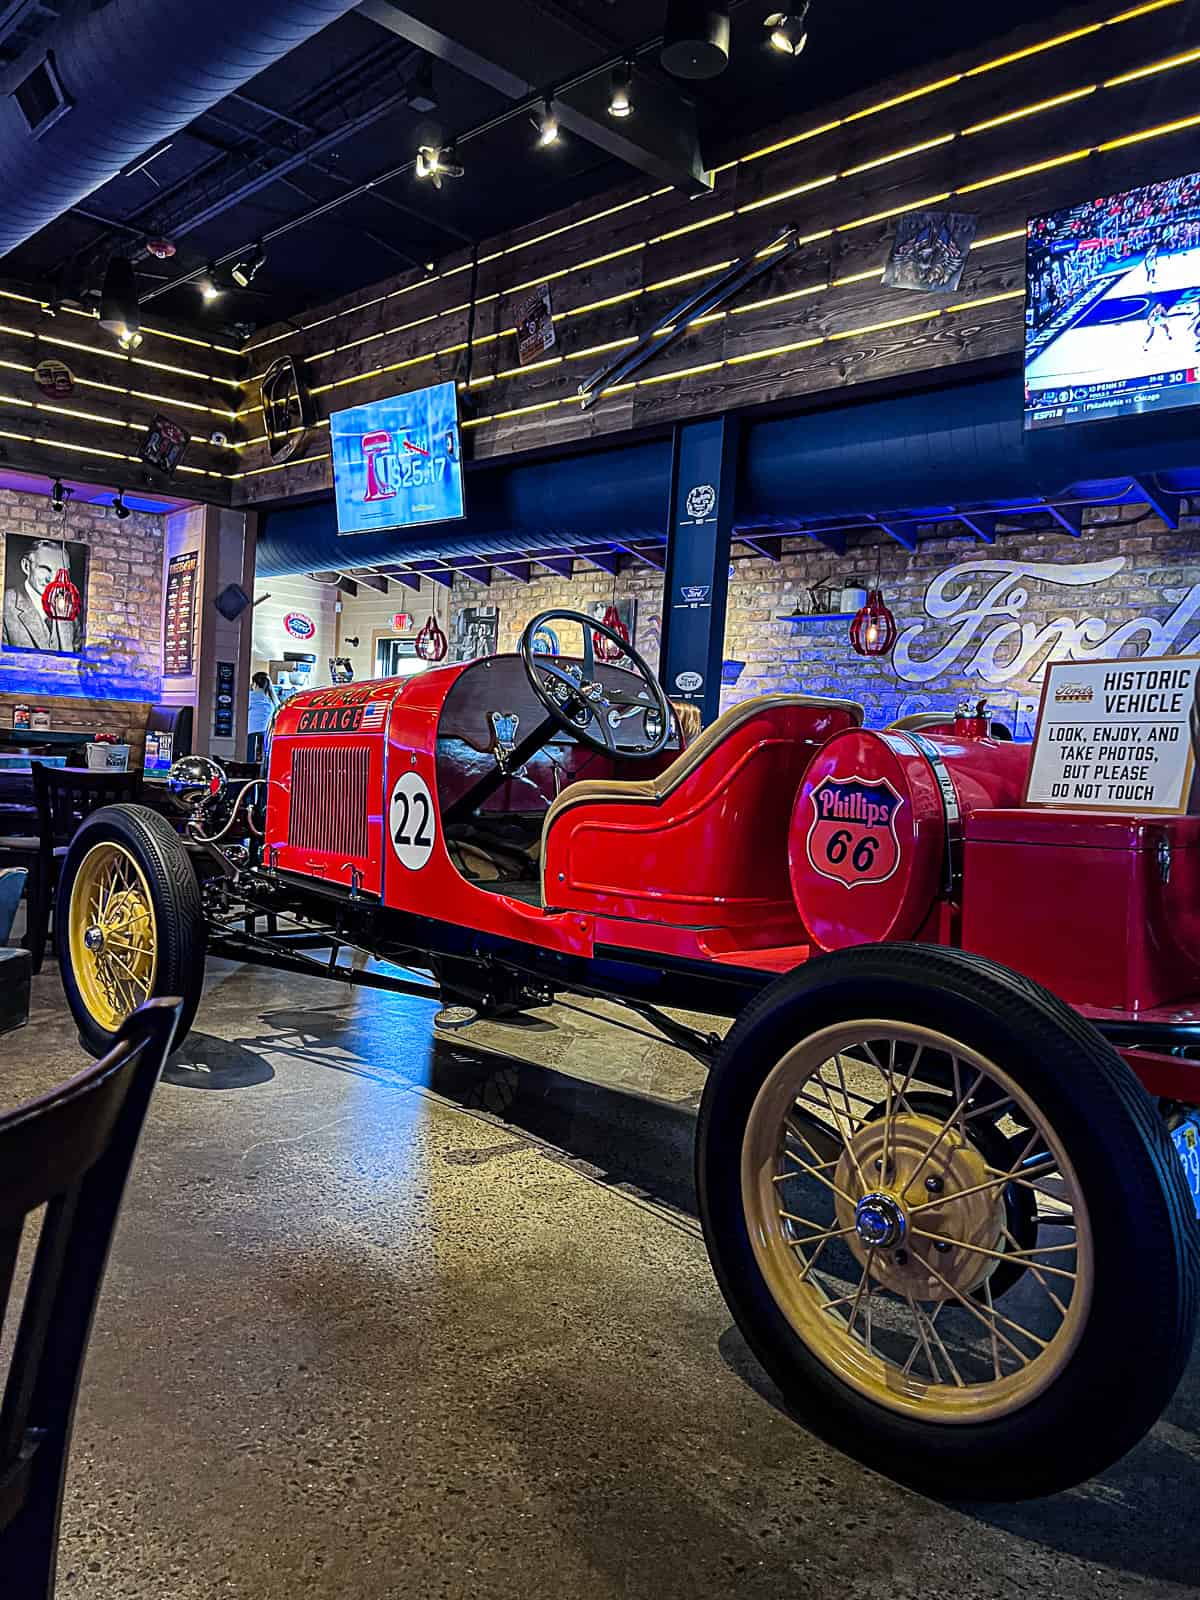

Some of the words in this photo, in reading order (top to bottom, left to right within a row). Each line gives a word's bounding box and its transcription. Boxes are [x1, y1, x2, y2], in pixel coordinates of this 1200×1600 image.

[1133, 393, 1160, 403] Chicago
[390, 456, 446, 489] $25.17
[1104, 669, 1191, 691] HISTORIC
[1105, 693, 1184, 713] VEHICLE
[300, 709, 362, 730] GARAGE
[1048, 727, 1087, 743] LOOK,
[1092, 727, 1141, 743] ENJOY,
[1147, 726, 1180, 742] AND
[1060, 745, 1095, 761] TAKE
[1098, 746, 1159, 764] PHOTOS,
[1063, 764, 1091, 780] BUT
[1094, 765, 1149, 781] PLEASE
[1051, 783, 1070, 798] DO
[1073, 783, 1102, 799] NOT
[1108, 784, 1154, 801] TOUCH
[819, 788, 889, 829] Phillips
[394, 791, 432, 847] 22
[826, 829, 880, 872] 66
